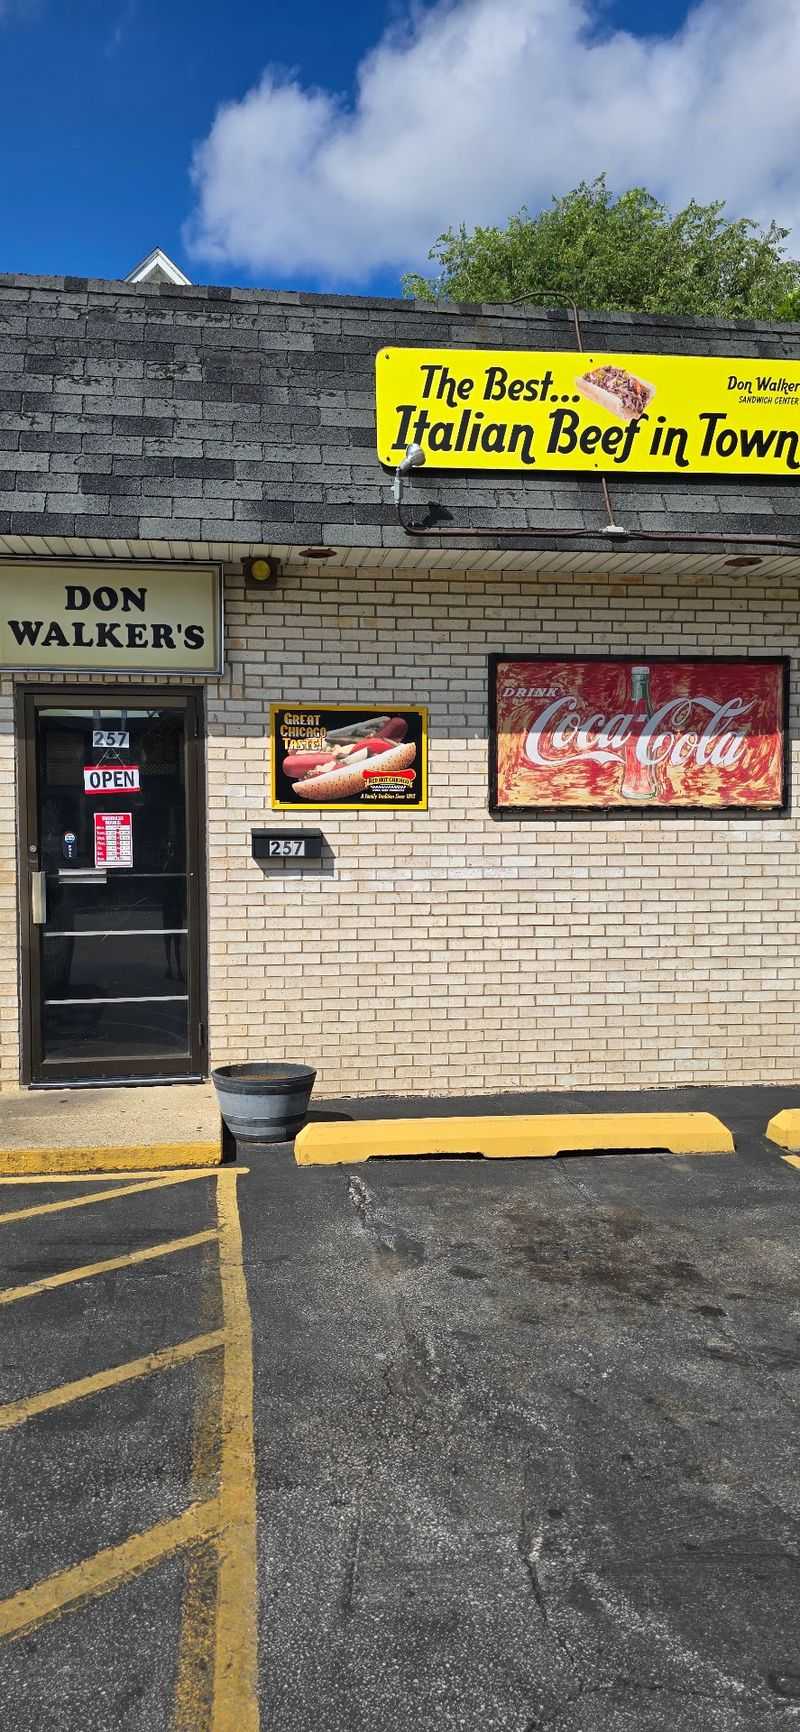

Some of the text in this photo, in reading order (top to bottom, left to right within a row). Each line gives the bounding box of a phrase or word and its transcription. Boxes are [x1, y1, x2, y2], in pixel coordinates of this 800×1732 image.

[420, 365, 581, 407] The Best...
[727, 375, 753, 394] Don
[738, 395, 799, 406] SANDWICH CENTER
[391, 405, 800, 470] Italian Beef in Town
[64, 585, 148, 613] DON
[7, 620, 205, 650] WALKER'S
[502, 687, 560, 698] DRINK
[283, 712, 321, 726] GREAT
[94, 732, 127, 747] 257
[280, 725, 328, 738] CHICAGO
[89, 771, 135, 789] OPEN
[270, 841, 304, 856] 257
